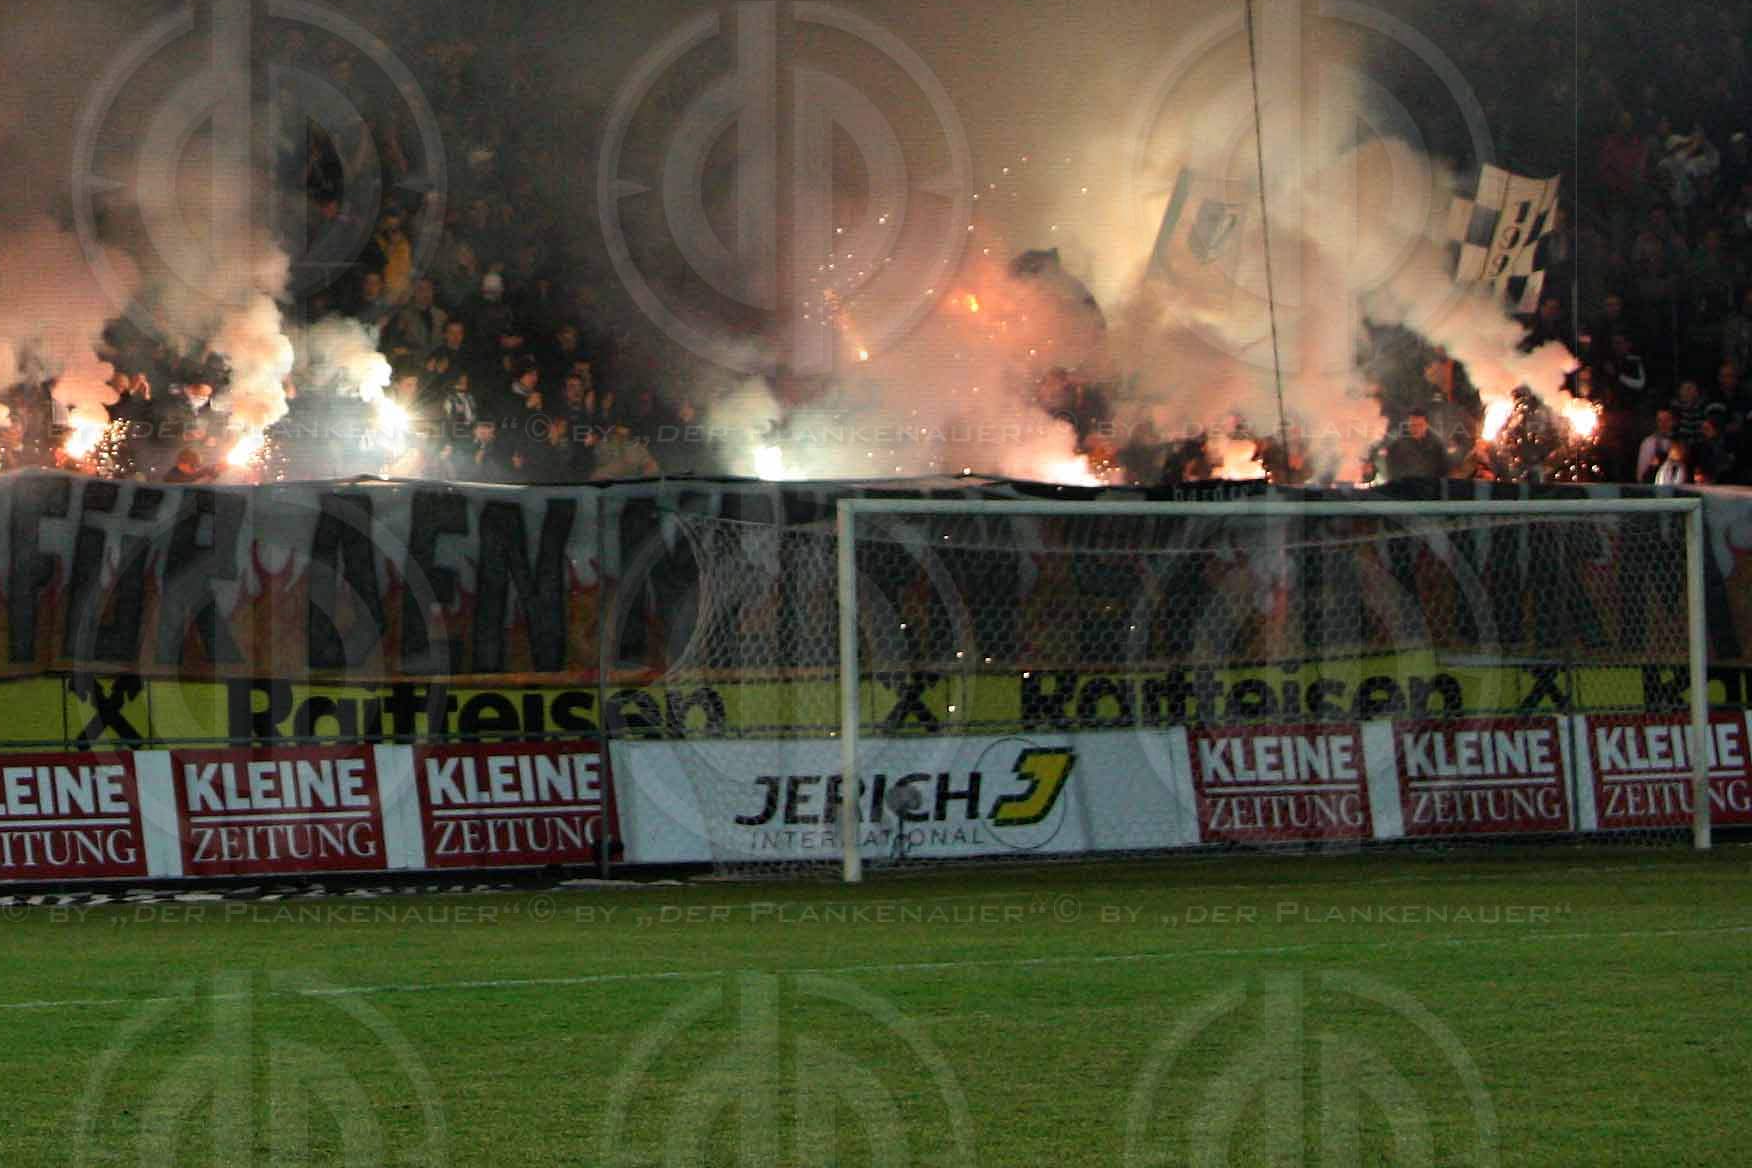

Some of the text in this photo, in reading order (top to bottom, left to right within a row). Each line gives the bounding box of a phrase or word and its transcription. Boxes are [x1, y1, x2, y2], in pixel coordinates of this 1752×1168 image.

[1200, 735, 1358, 783] KLEINE
[1404, 729, 1555, 776] KLEINE
[185, 758, 370, 811] KLEINE
[425, 753, 601, 805] KLEINE
[735, 771, 982, 826] JERICH
[1205, 792, 1366, 831] ZEITUNG
[1409, 784, 1562, 825] ZEITUNG
[191, 823, 376, 862] ZEITUNG
[751, 826, 985, 850] INTERATONAL
